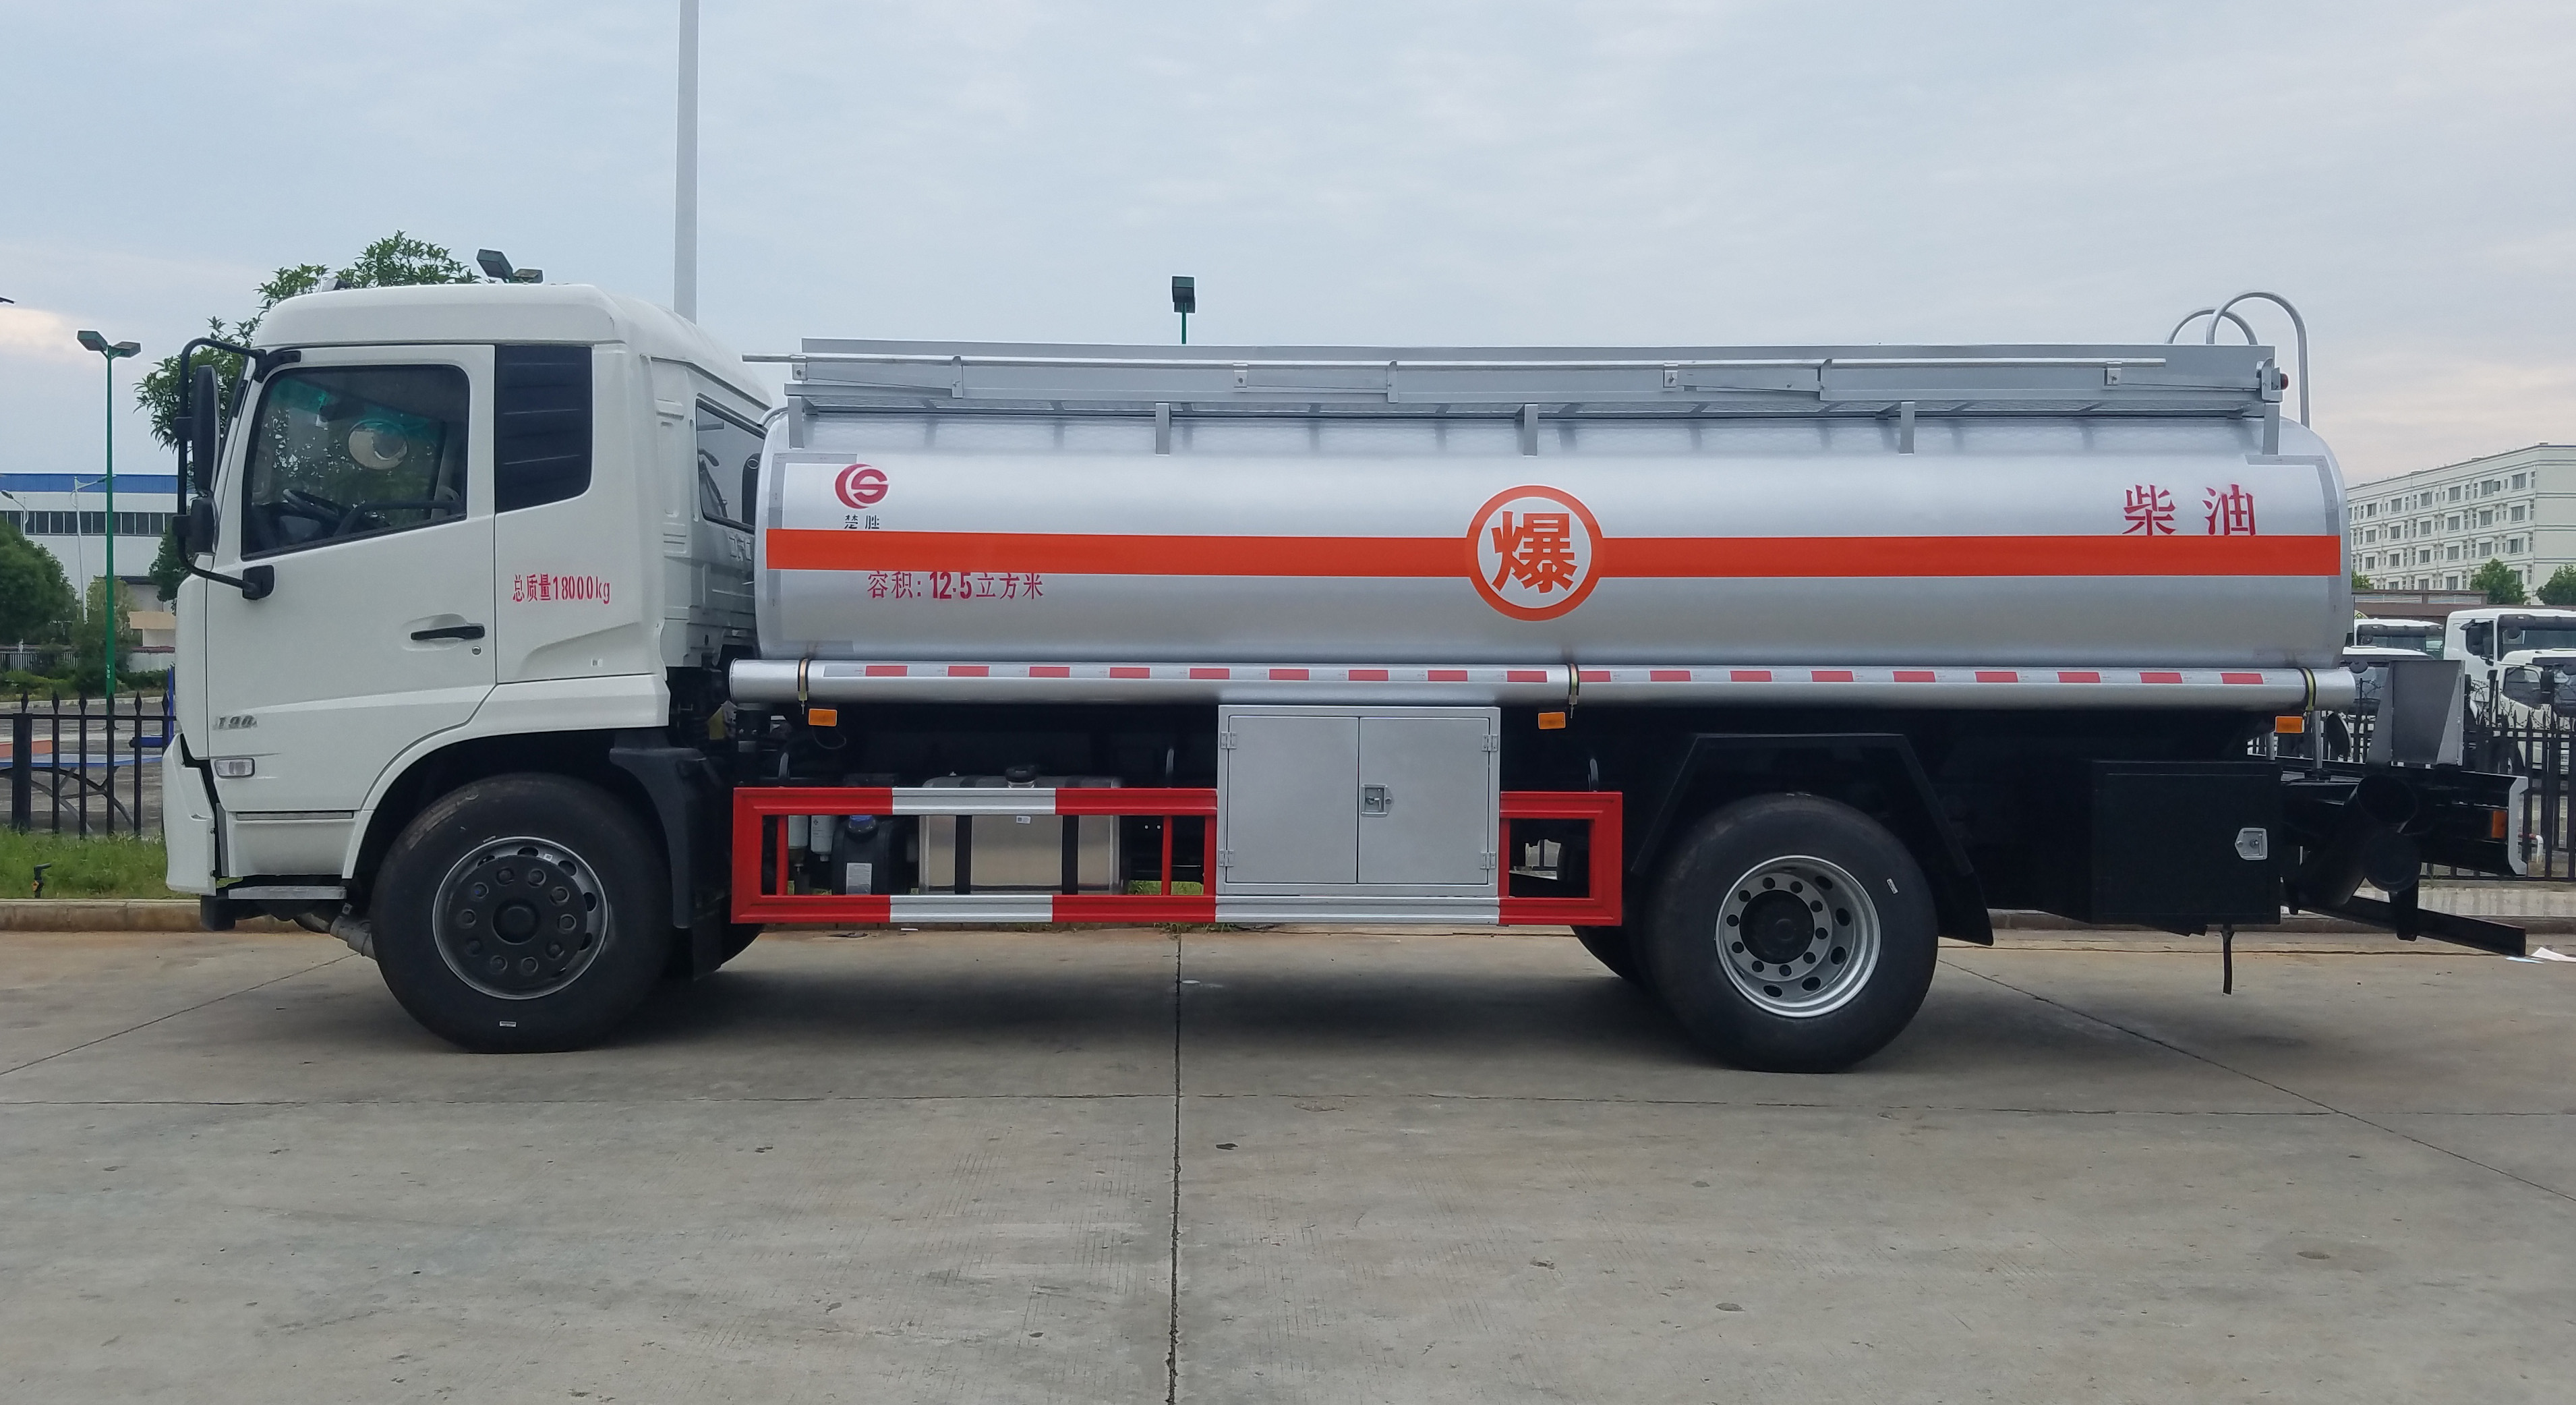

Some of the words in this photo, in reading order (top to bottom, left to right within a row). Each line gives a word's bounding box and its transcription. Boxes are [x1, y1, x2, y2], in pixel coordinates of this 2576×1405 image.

[844, 514, 879, 529] 楚胜
[2122, 484, 2256, 536] 柴油
[1490, 511, 1578, 594] 爆
